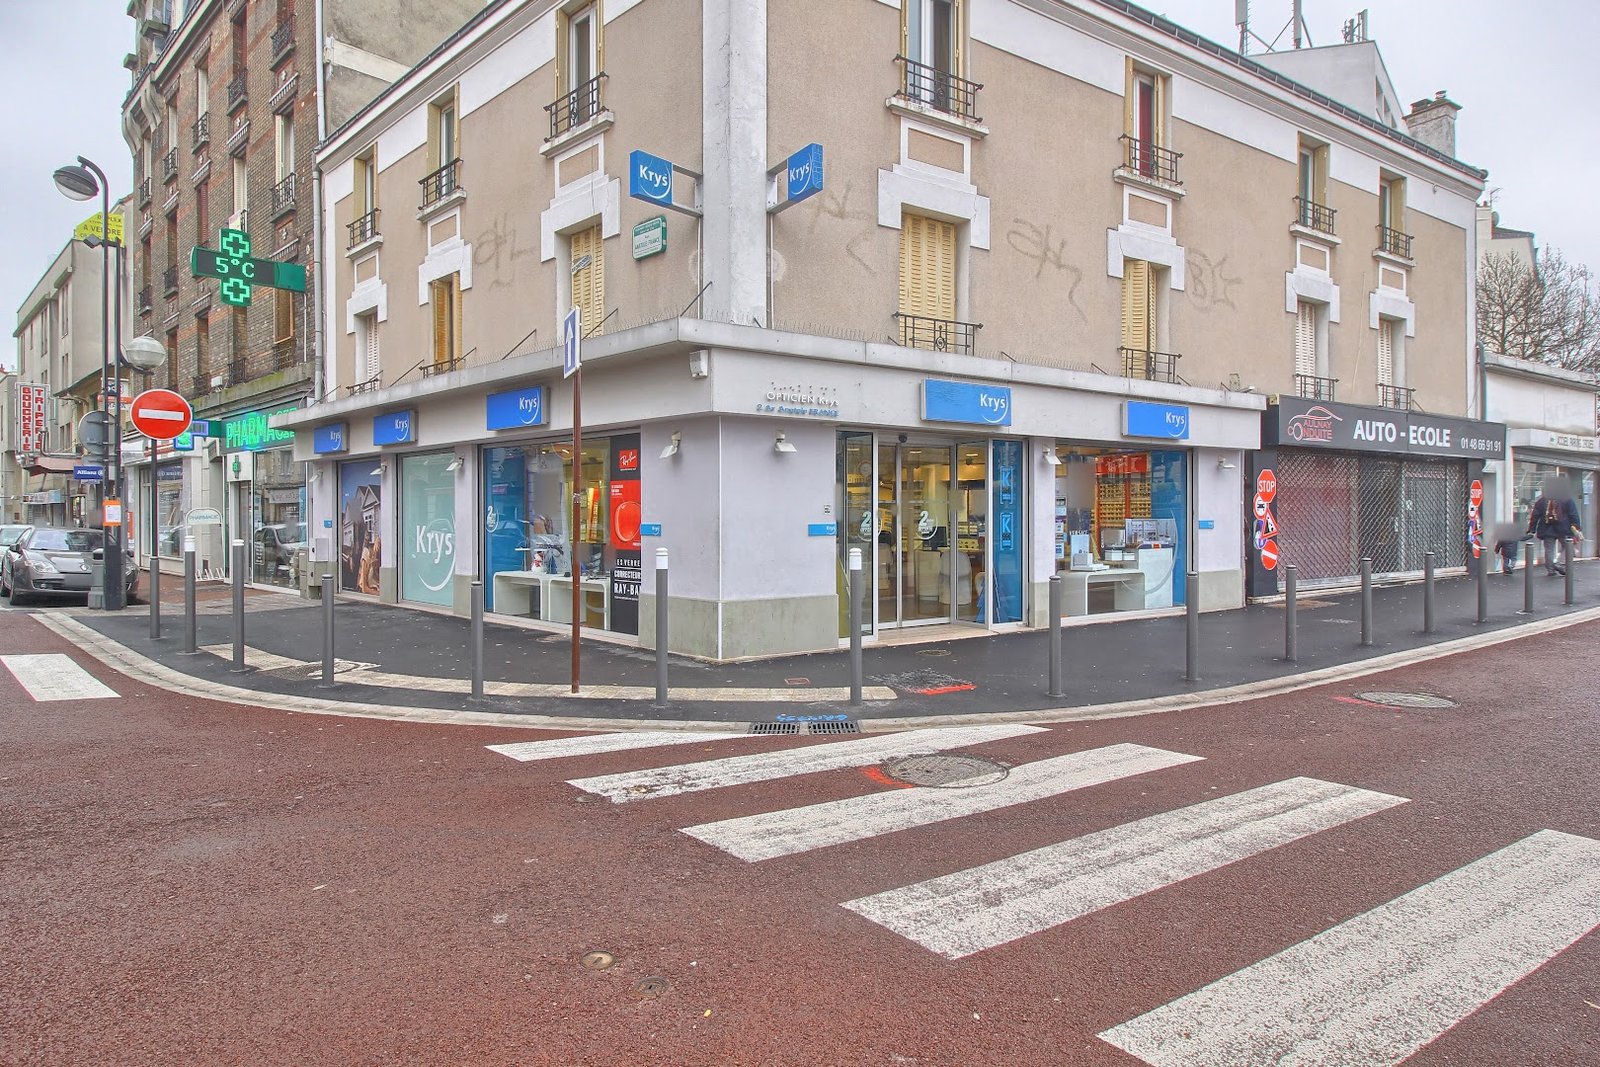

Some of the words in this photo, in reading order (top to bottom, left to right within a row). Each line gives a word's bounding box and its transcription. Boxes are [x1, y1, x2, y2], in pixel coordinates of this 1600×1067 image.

[639, 164, 668, 188] Krys
[789, 162, 810, 182] Krys
[90, 225, 121, 236] VEDRE
[519, 397, 537, 412] Krys
[766, 391, 815, 404] OPTICIEN
[980, 394, 1005, 412] Krys
[22, 387, 32, 451] BOUCHERIE
[394, 419, 408, 431] Krys
[1165, 411, 1185, 427] Krys
[1303, 419, 1332, 428] AULNAY
[330, 431, 341, 442] Krys
[1353, 419, 1397, 443] AUTO
[1409, 425, 1451, 447] ECOLE
[1258, 480, 1275, 493] STOP
[1470, 489, 1482, 498] STOP
[416, 525, 453, 564] Krys
